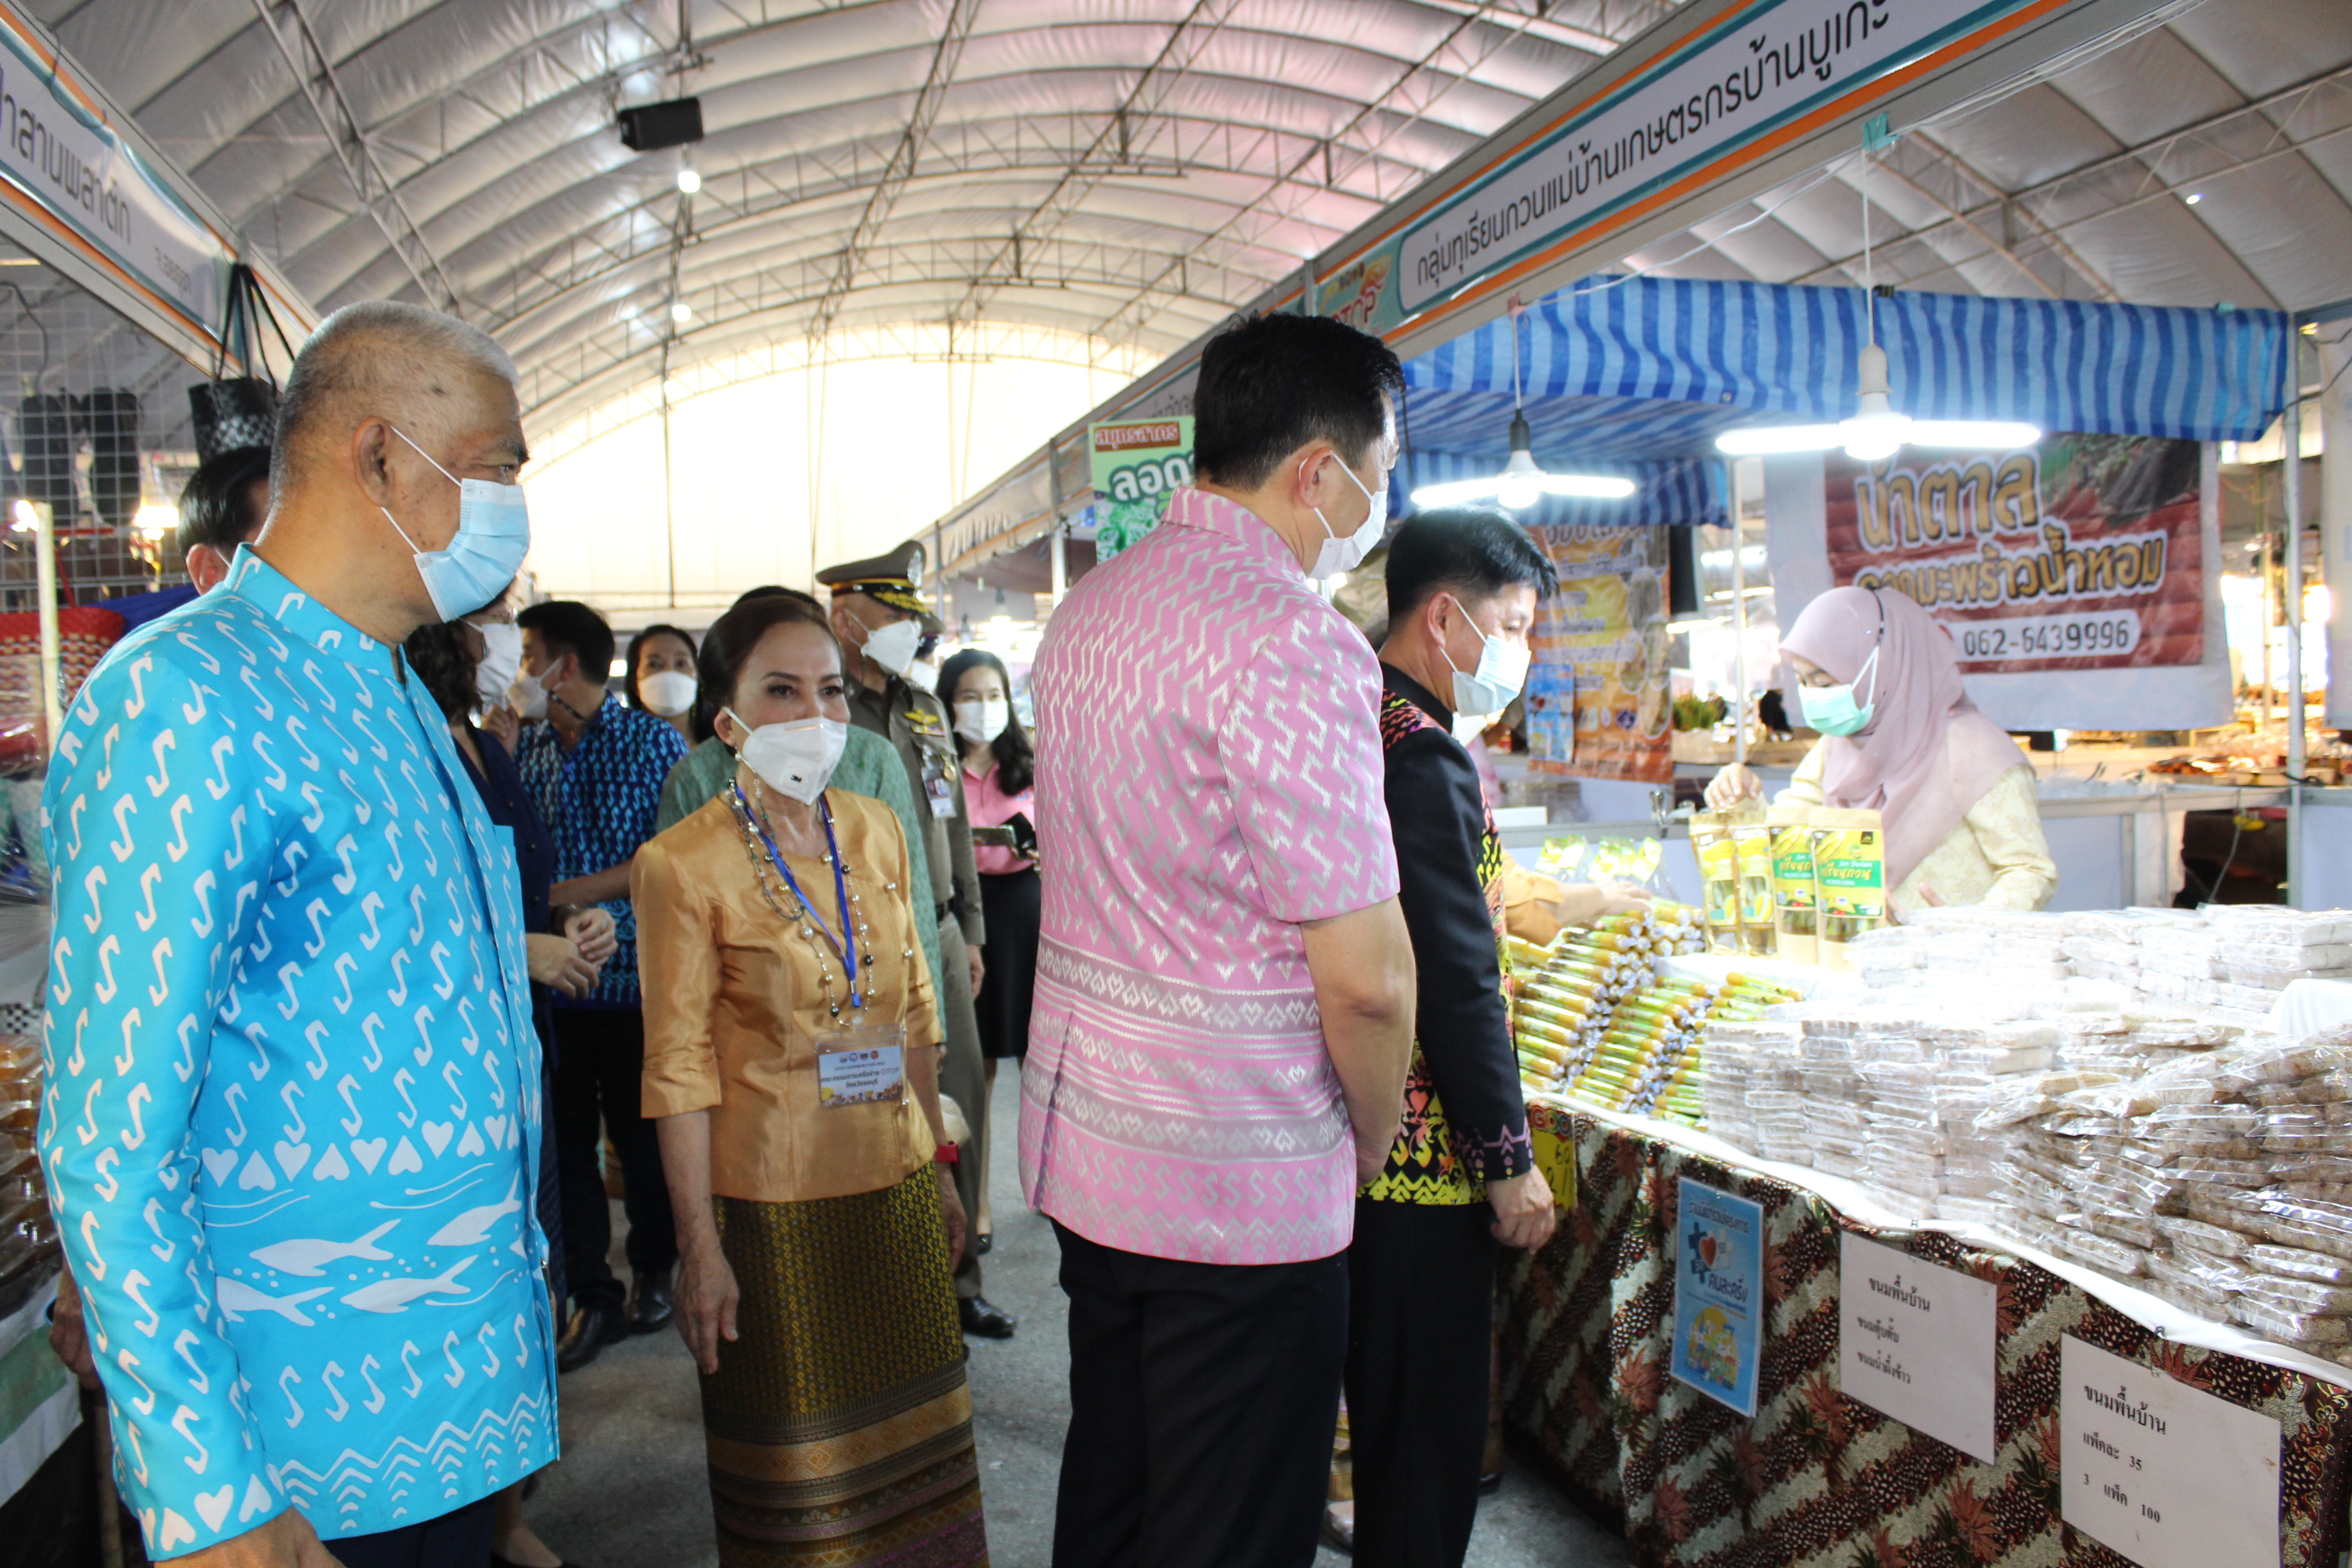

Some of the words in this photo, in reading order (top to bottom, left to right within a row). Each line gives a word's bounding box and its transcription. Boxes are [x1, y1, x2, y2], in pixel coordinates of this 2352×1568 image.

[1112, 454, 1195, 501] ลอด
[1963, 619, 2129, 655] 062-6439996
[1869, 1275, 1931, 1312] ขนมพื้นบ้าน
[2084, 1386, 2166, 1435] ขนมพื้นบ้าน
[2083, 1432, 2119, 1459] แพ็คละ
[2129, 1455, 2142, 1471] 35
[2083, 1473, 2090, 1485] 3
[2104, 1484, 2127, 1506] แพ็ค
[2141, 1504, 2161, 1523] 100
